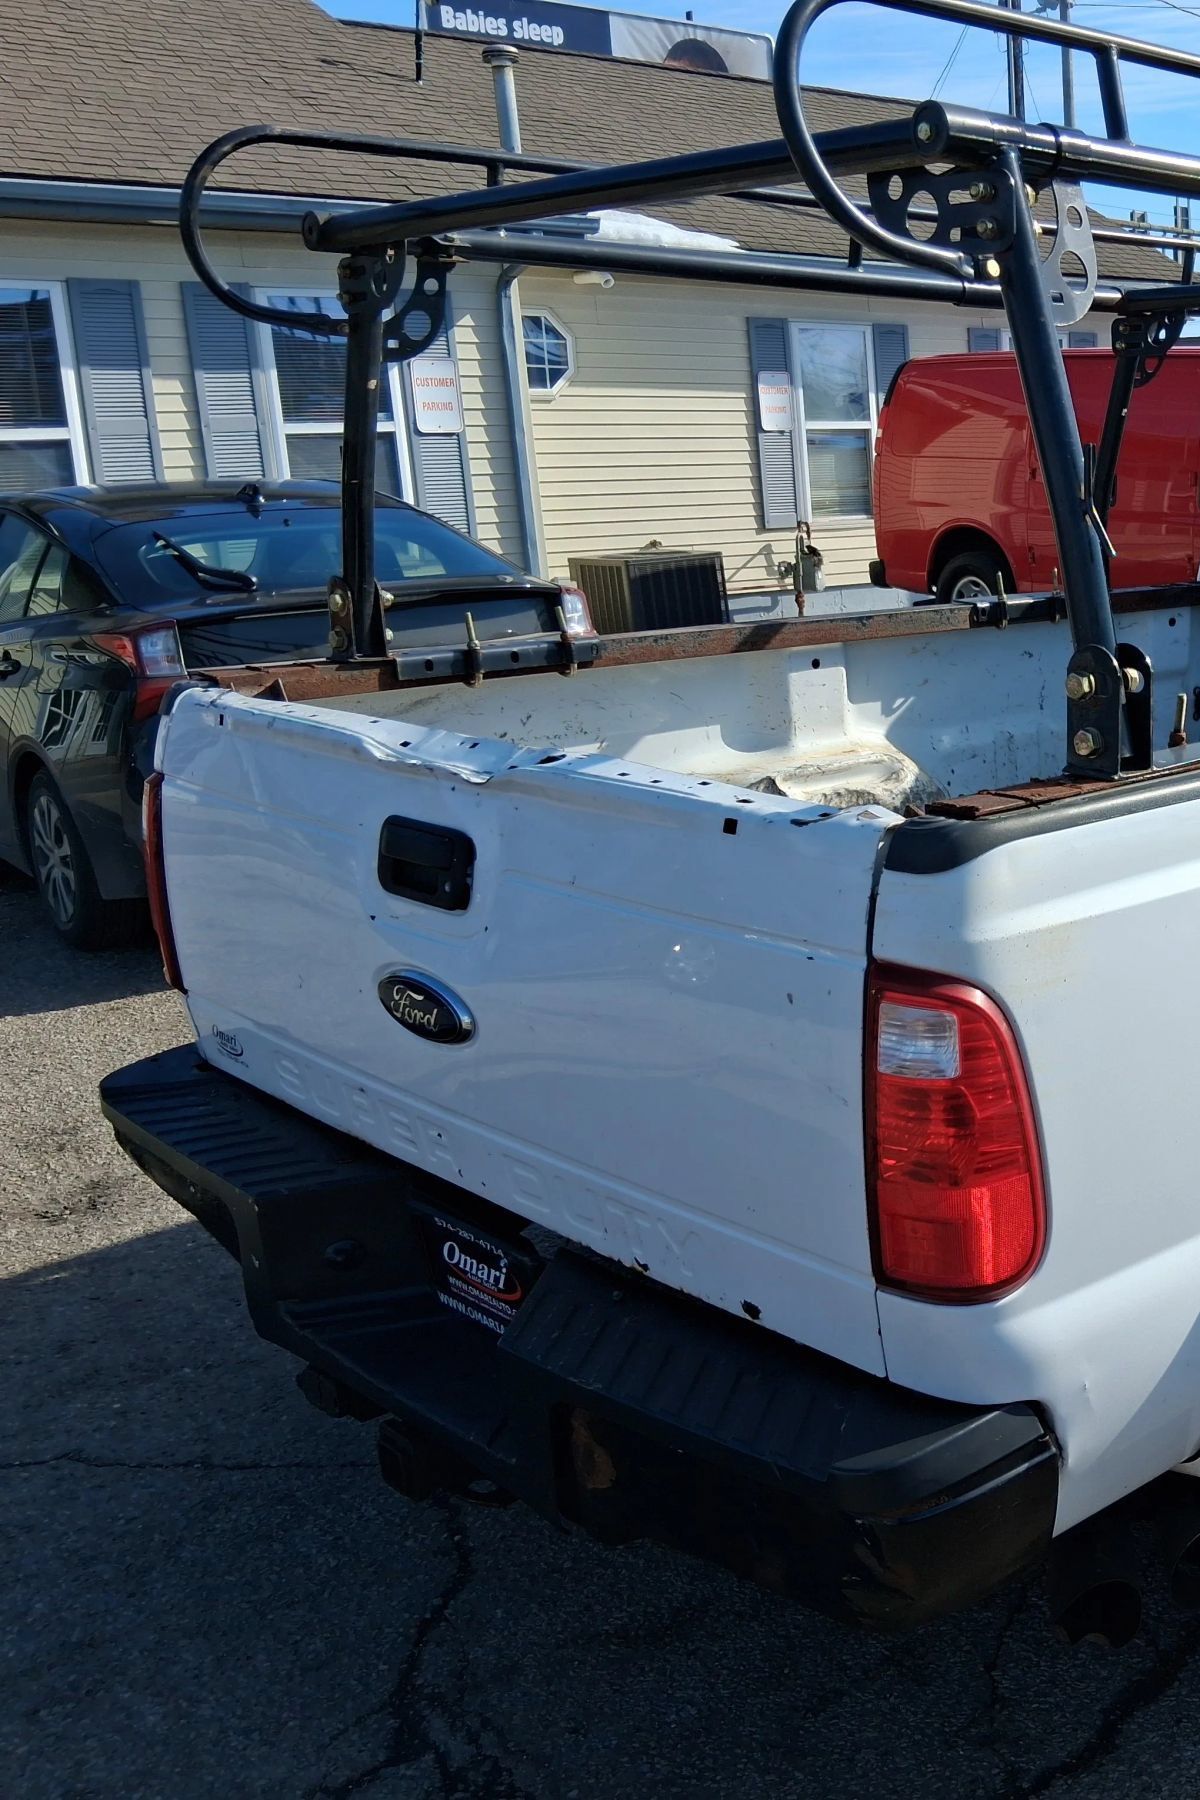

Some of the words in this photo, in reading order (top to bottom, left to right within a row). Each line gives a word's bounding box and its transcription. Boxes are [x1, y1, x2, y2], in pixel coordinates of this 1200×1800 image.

[440, 5, 508, 37] Babies
[513, 17, 564, 46] sleep
[416, 377, 455, 388] CUSTOMER
[422, 401, 454, 412] PARKING
[391, 984, 439, 1032] Ford
[212, 1024, 237, 1047] Omari
[273, 1049, 461, 1175] SUPER
[503, 1152, 699, 1277] DUTY
[443, 1241, 508, 1290] Omari
